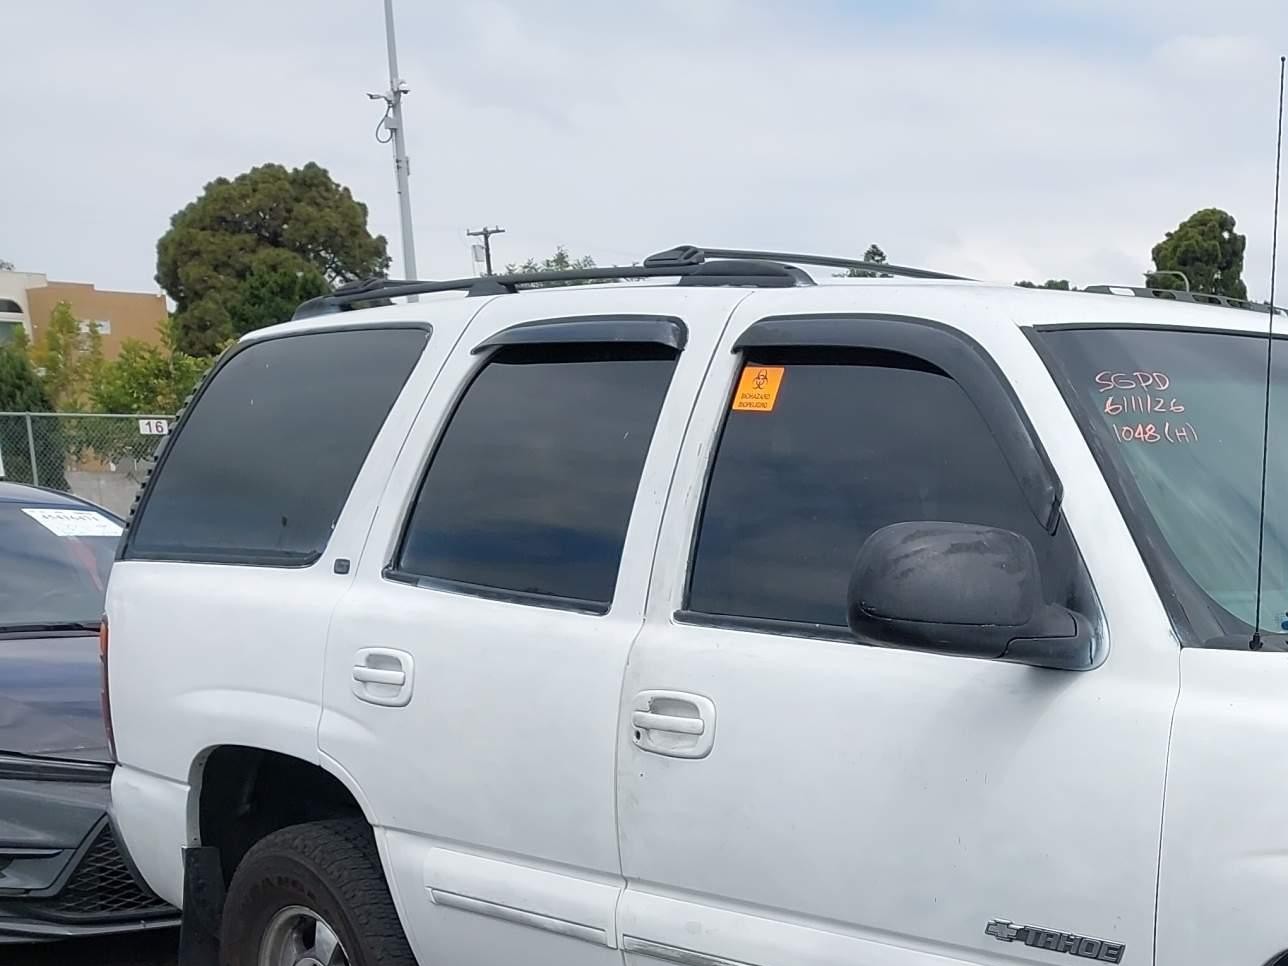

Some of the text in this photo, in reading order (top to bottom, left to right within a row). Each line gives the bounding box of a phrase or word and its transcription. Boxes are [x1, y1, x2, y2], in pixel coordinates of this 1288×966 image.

[1095, 371, 1170, 392] SGPD
[145, 421, 164, 433] 16
[1025, 928, 1125, 963] TAHOE
